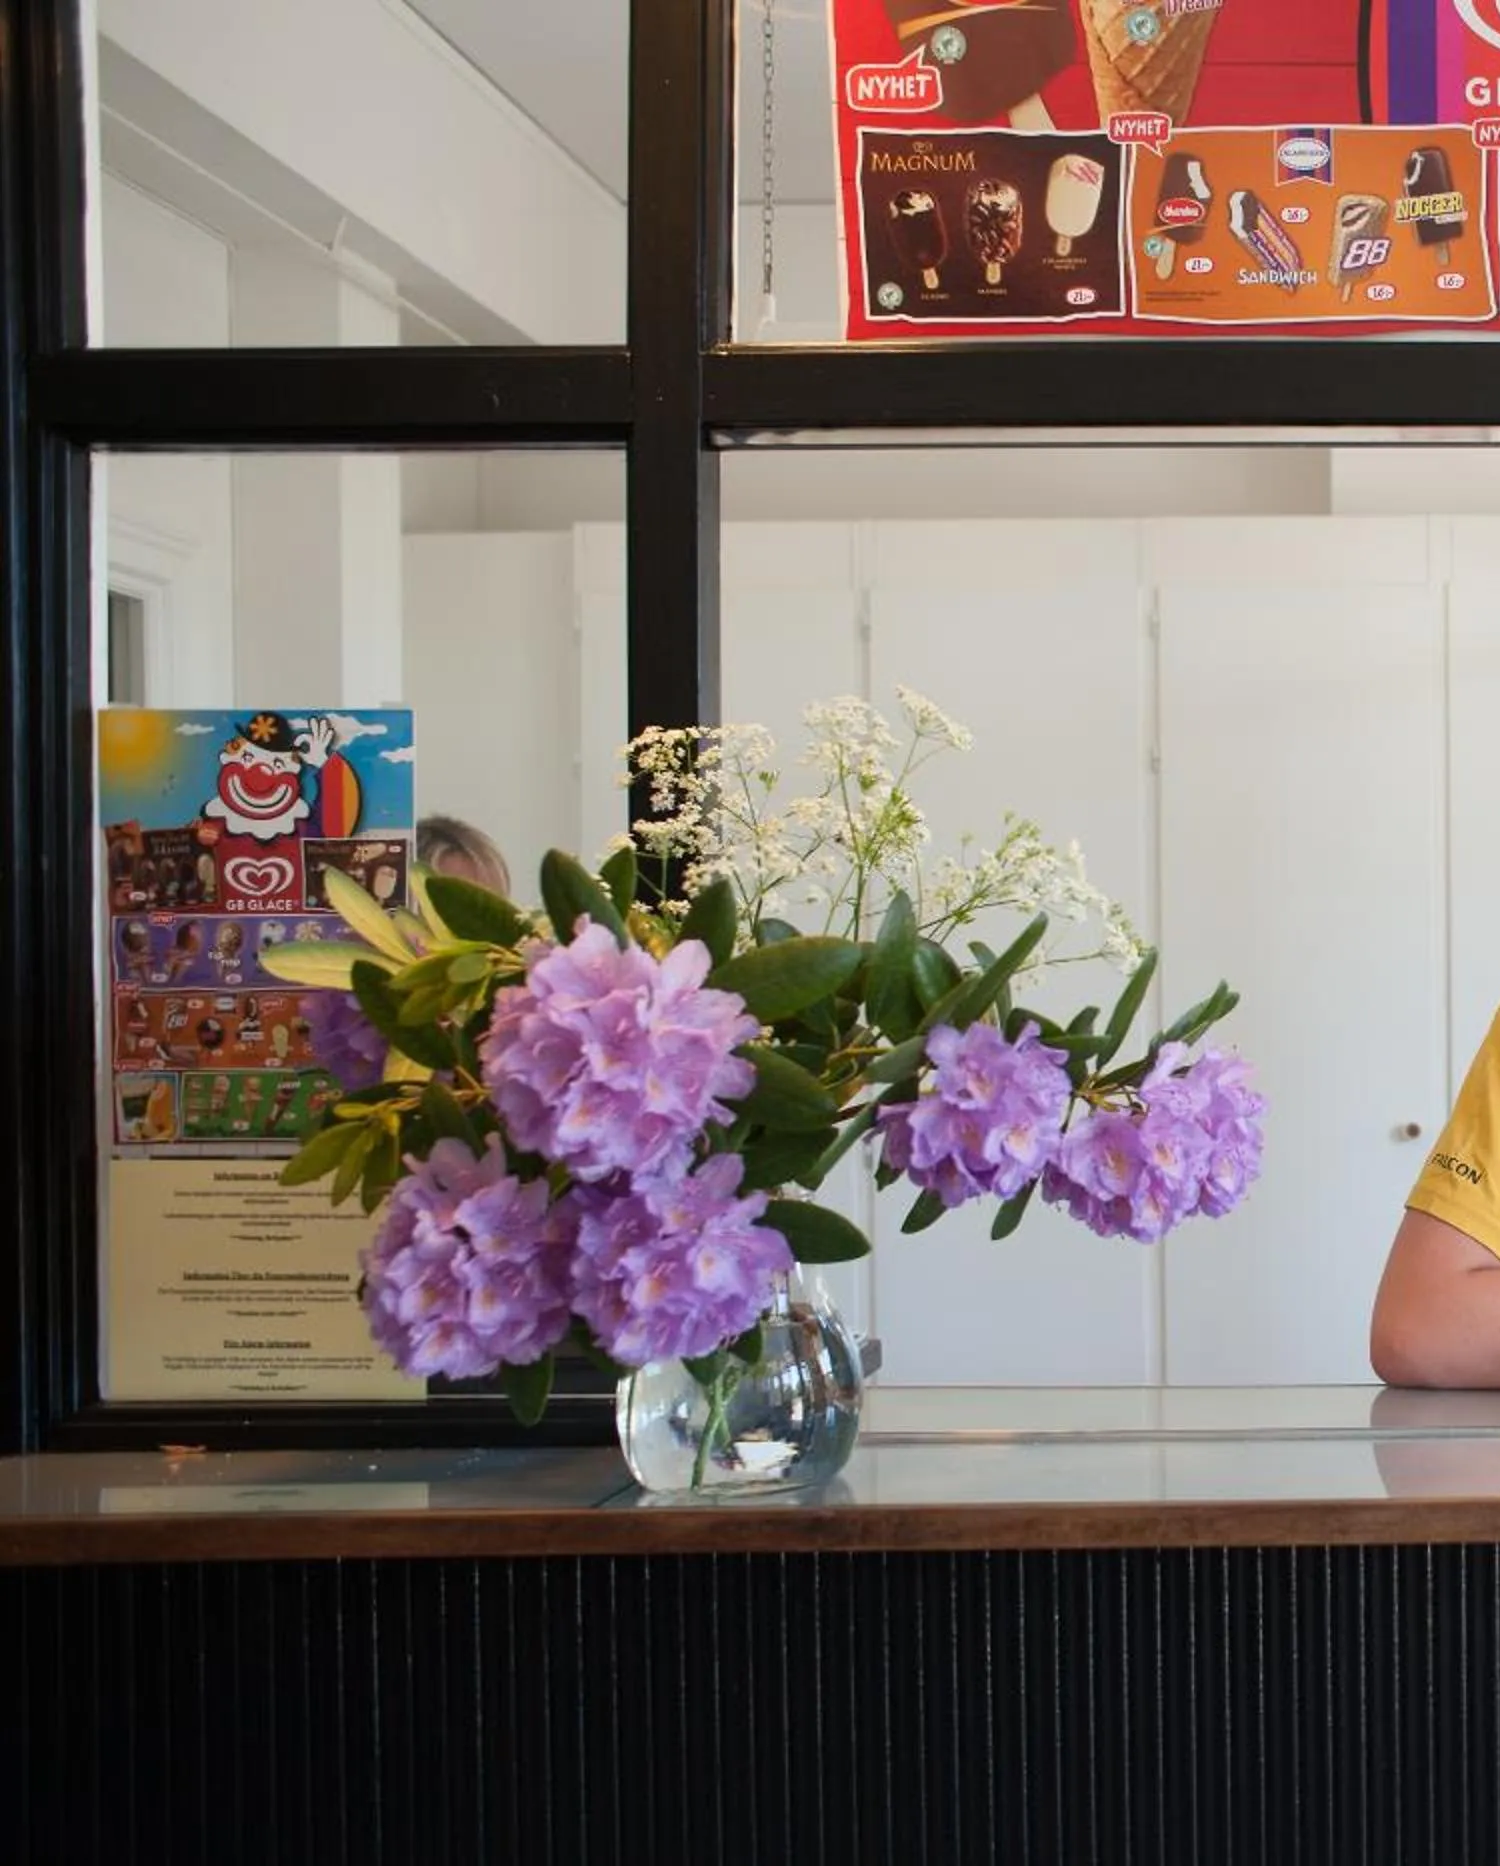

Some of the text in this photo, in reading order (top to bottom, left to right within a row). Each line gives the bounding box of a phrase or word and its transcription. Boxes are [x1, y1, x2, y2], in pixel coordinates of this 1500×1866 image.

[857, 74, 932, 100] NYHET
[1114, 119, 1166, 136] NYHET
[870, 151, 976, 172] MAGNUM
[1395, 191, 1463, 219] NOGGER
[1341, 238, 1391, 269] 88
[226, 898, 293, 911] GB GLACE
